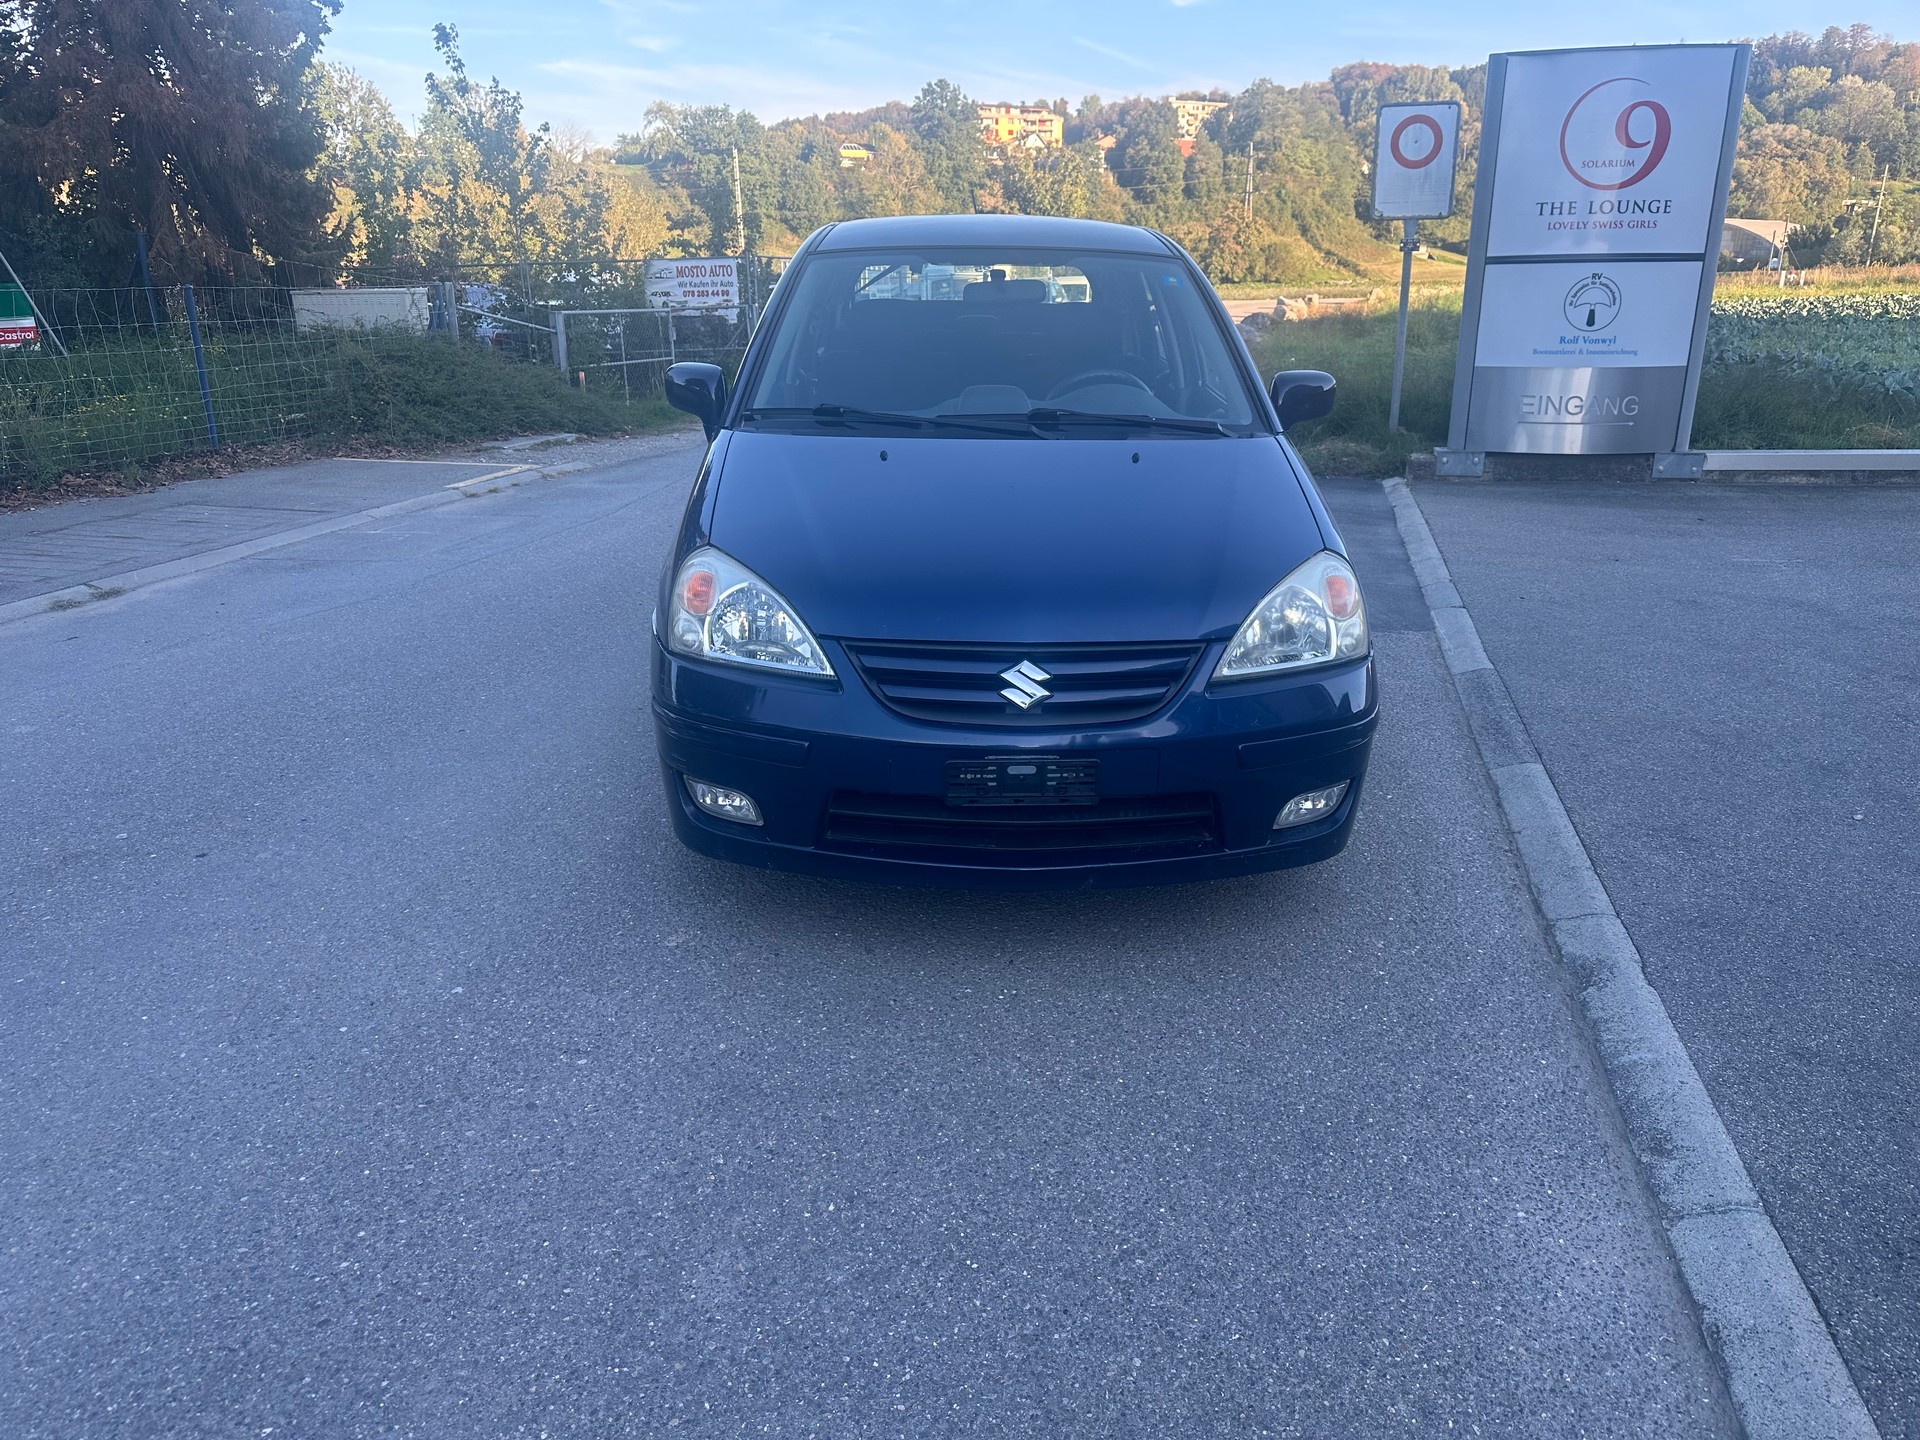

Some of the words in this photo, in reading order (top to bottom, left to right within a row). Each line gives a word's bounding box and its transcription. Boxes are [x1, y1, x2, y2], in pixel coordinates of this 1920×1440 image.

[1581, 159, 1635, 168] SOLARIUM
[1536, 201, 1577, 216] THE
[1588, 199, 1672, 215] LOUNGE
[1547, 221, 1589, 231] LOVELY
[1591, 220, 1624, 230] SWISS
[1627, 220, 1658, 229] GIRLS
[675, 265, 707, 278] MOSTO
[709, 264, 733, 277] AUTO
[1591, 272, 1603, 280] RV
[689, 280, 709, 288] Kaufen
[720, 280, 734, 288] Auto
[710, 289, 720, 297] 44
[0, 330, 34, 341] Castrol
[1559, 335, 1580, 345] Rolf
[1582, 335, 1617, 347] Vonwyl
[1520, 395, 1639, 416] EINGANG
